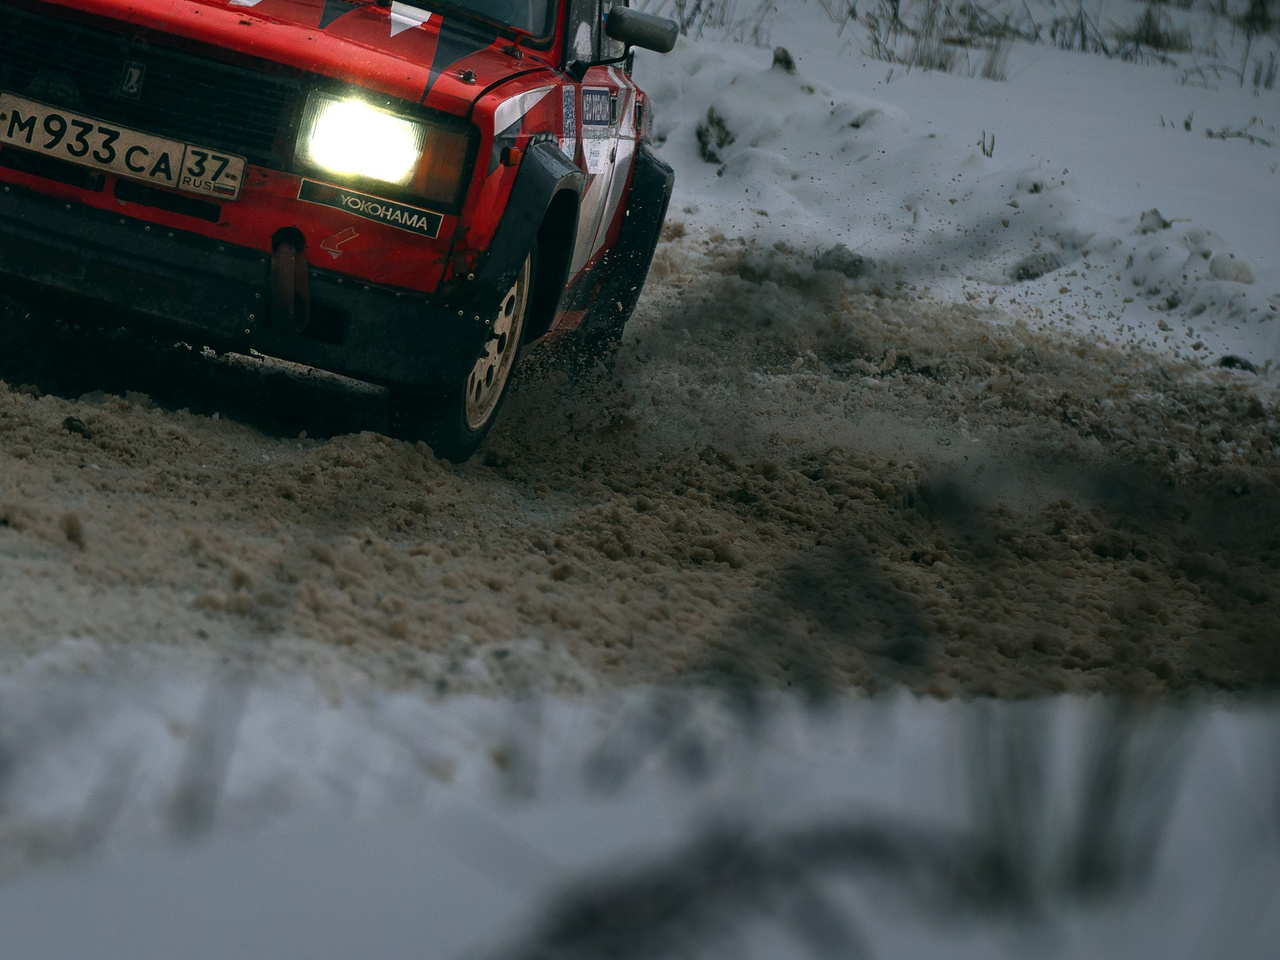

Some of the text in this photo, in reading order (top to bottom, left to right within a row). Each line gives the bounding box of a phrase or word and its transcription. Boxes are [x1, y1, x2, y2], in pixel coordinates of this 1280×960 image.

[187, 150, 230, 182] 37
[182, 175, 212, 191] RUS
[341, 193, 428, 231] YOKOHAMA
